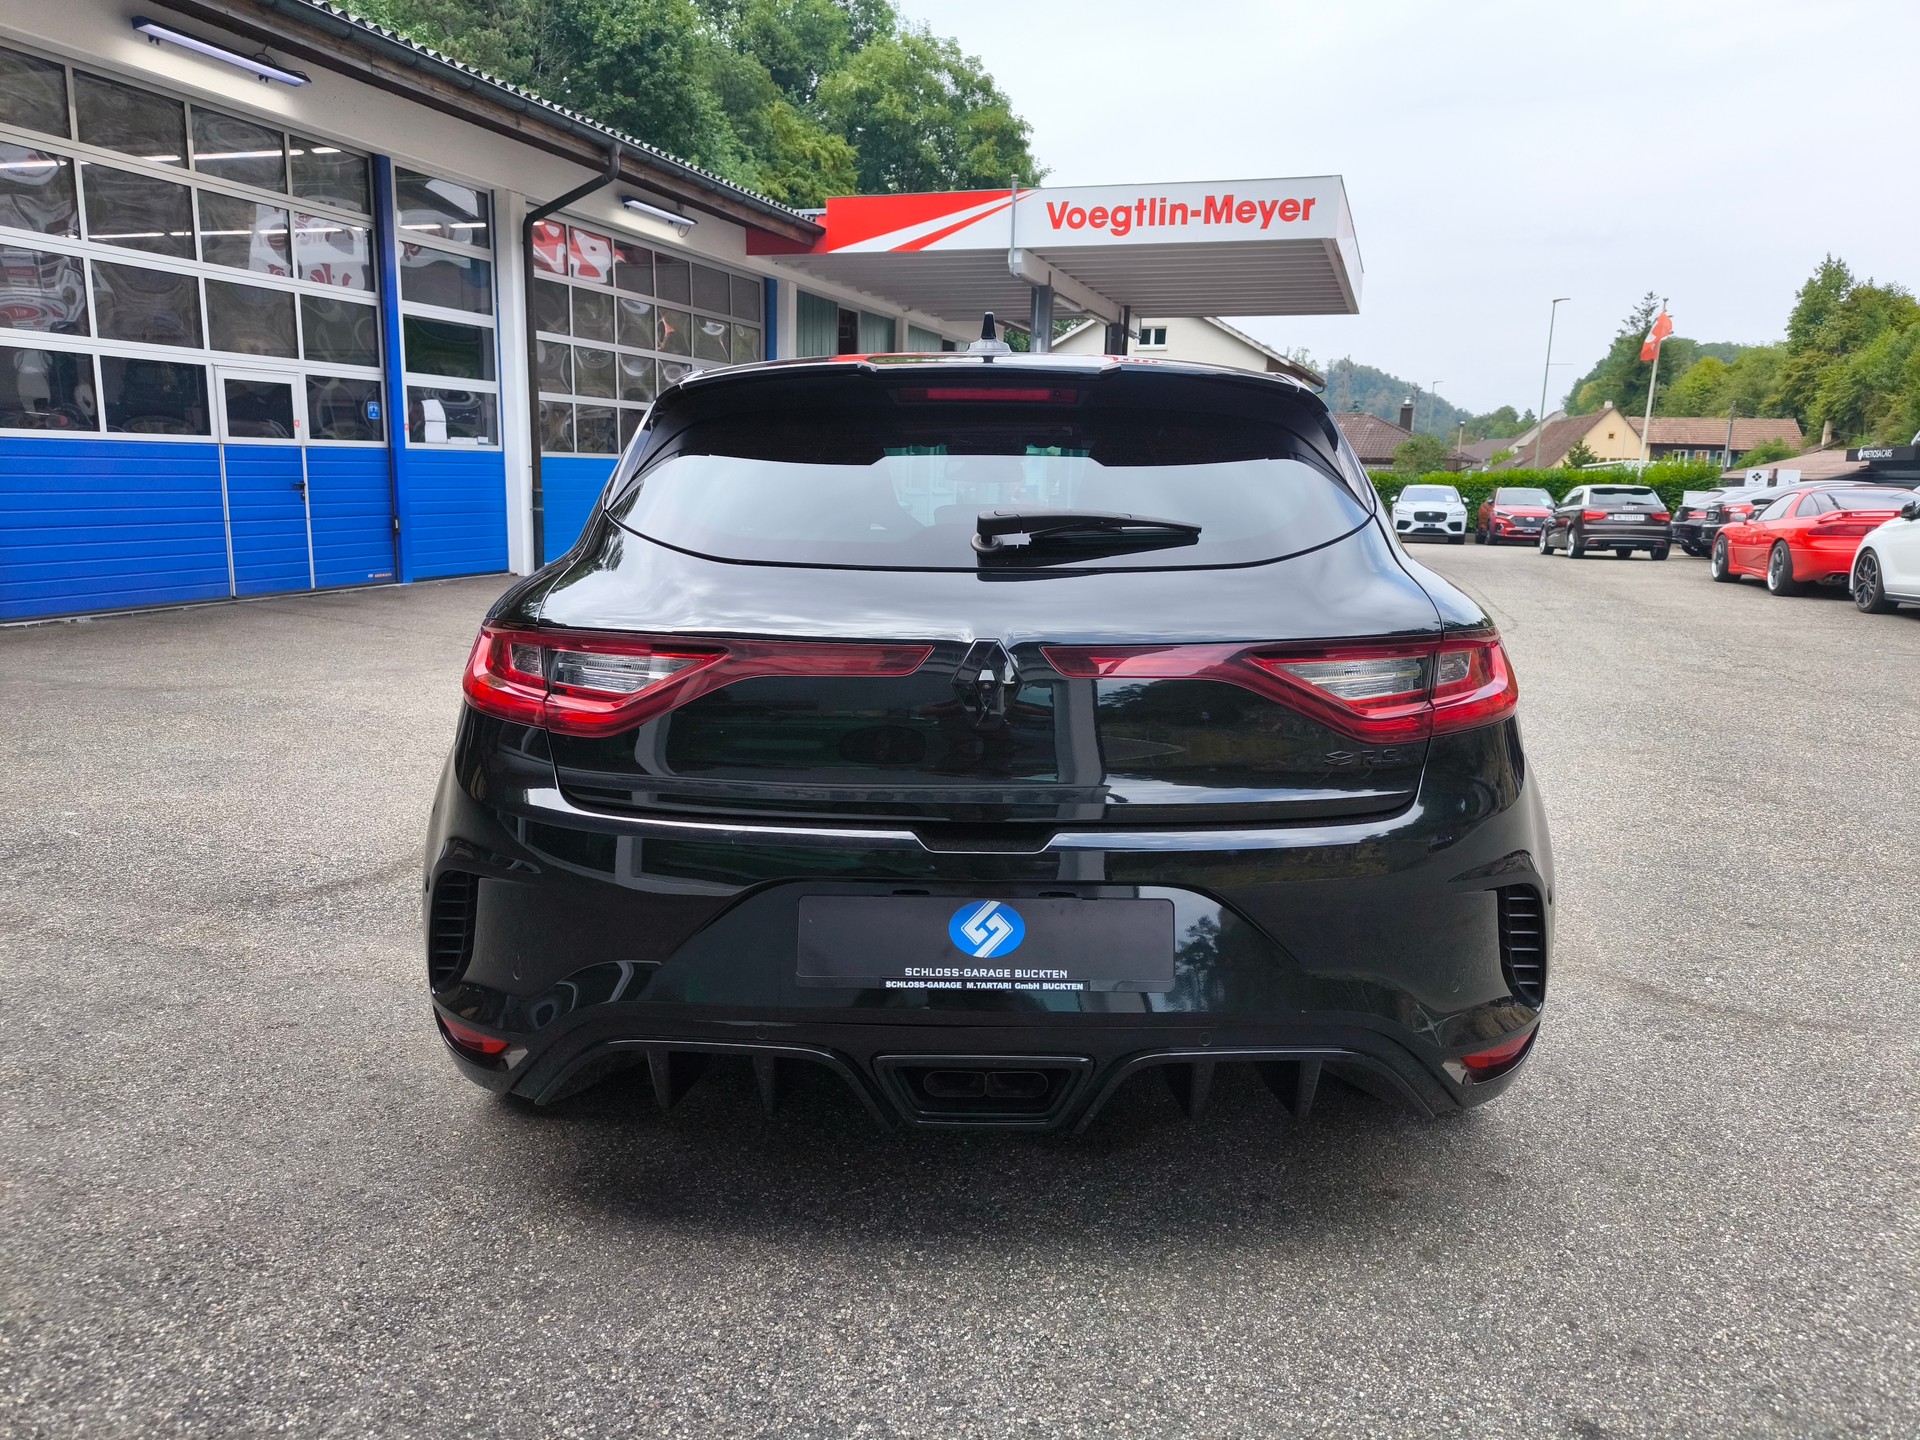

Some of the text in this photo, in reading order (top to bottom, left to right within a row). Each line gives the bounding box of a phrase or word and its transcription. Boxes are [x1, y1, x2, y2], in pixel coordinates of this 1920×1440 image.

[1046, 194, 1316, 237] Voegtlin-Meyer
[904, 967, 1068, 979] SCHLOSS-GARAGE BUCKTEN
[885, 980, 1084, 991] SCHLOSS-GARAGE M.TARTARI GmbH BUCKTEN
